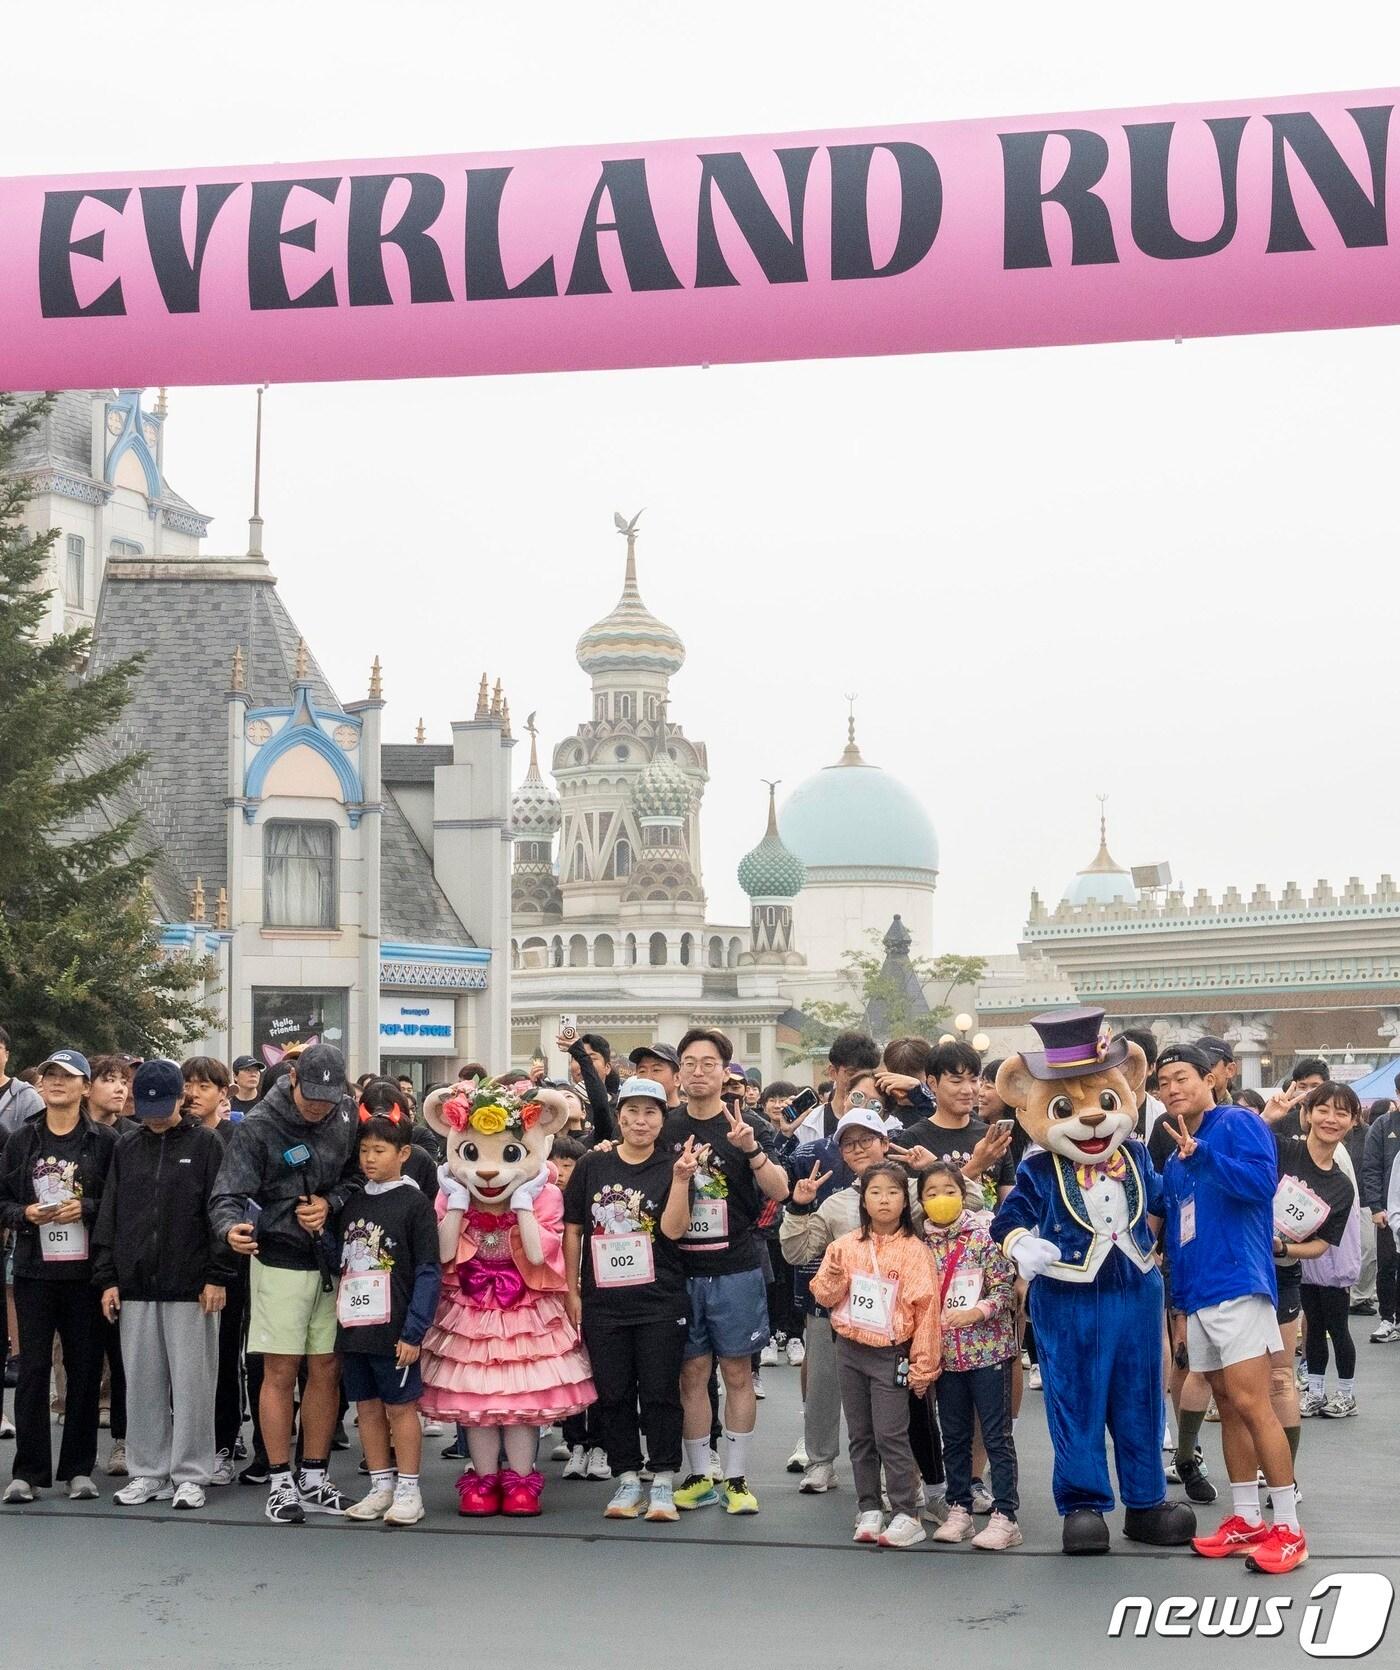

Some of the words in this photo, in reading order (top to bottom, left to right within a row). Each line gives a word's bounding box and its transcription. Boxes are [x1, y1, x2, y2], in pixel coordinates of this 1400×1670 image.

[38, 140, 943, 319] EVERLAND
[1002, 106, 1390, 270] RUN
[272, 1017, 294, 1029] Hello
[269, 1024, 300, 1037] Friends!
[380, 1023, 420, 1036] POP-UP
[420, 1024, 452, 1037] STORE
[1285, 1203, 1305, 1221] 213
[48, 1231, 68, 1242] 051
[610, 1255, 634, 1268] 002
[350, 1294, 370, 1307] 365
[852, 1294, 874, 1309] 193
[946, 1295, 967, 1309] 362
